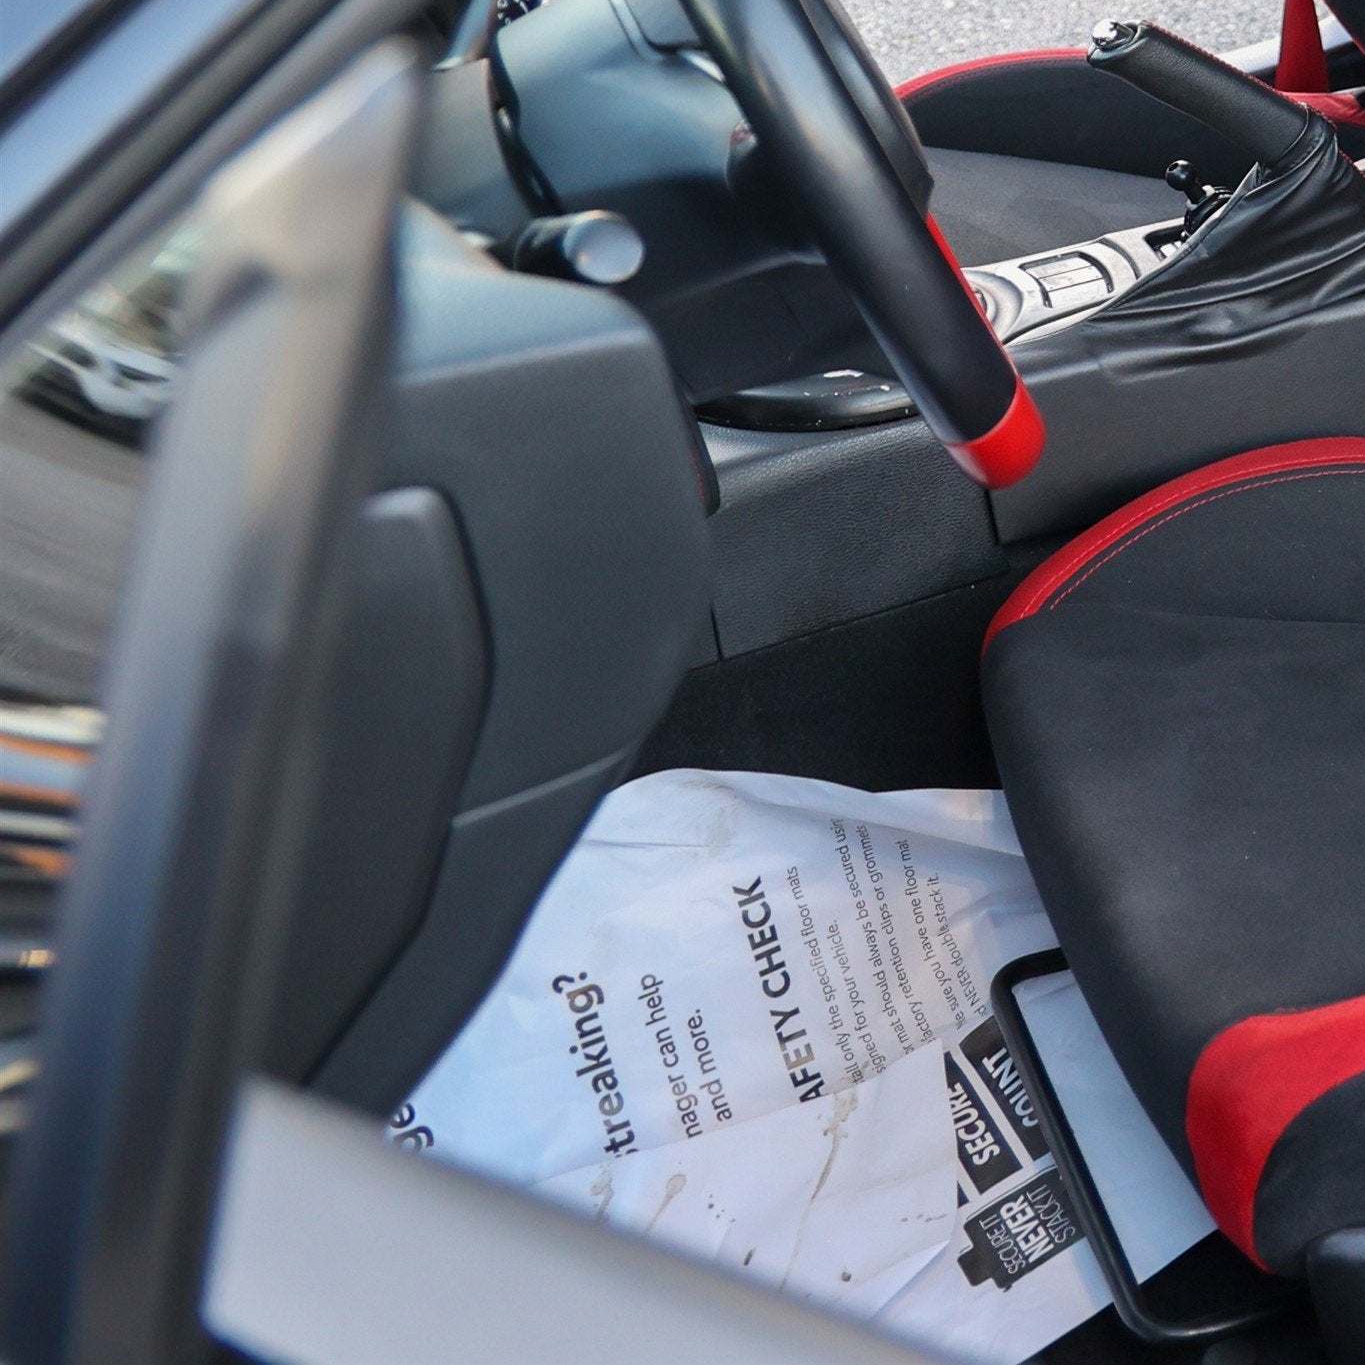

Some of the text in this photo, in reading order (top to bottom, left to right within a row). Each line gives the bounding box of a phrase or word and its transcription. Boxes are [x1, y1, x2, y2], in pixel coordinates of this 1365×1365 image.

[834, 844, 864, 899] secured
[852, 822, 884, 884] grommets
[783, 865, 805, 900] mats
[871, 883, 888, 901] or
[924, 871, 941, 887] it.
[792, 902, 816, 937] floor
[850, 898, 869, 920] be
[874, 902, 897, 936] clips
[894, 837, 960, 1012] sure you have one floor mat
[926, 887, 950, 923] stack
[731, 875, 793, 997] CHECK
[821, 918, 853, 975] vehicle.
[857, 919, 886, 969] always
[937, 923, 964, 966] double
[802, 936, 836, 1004] specified
[883, 935, 915, 1000] retention
[955, 963, 982, 1007] NEVER
[631, 970, 674, 1025] help
[841, 974, 864, 1008] your
[870, 969, 899, 1018] should
[824, 1003, 843, 1030] the
[849, 1008, 869, 1032] for
[888, 1016, 909, 1044] mat
[905, 998, 935, 1042] factory
[652, 1026, 681, 1068] can
[682, 1007, 733, 1124] and more.
[832, 1030, 857, 1062] only
[1000, 1193, 1055, 1264] NEVER
[1034, 1194, 1076, 1244] STACK
[986, 1227, 1026, 1275] SECURE
